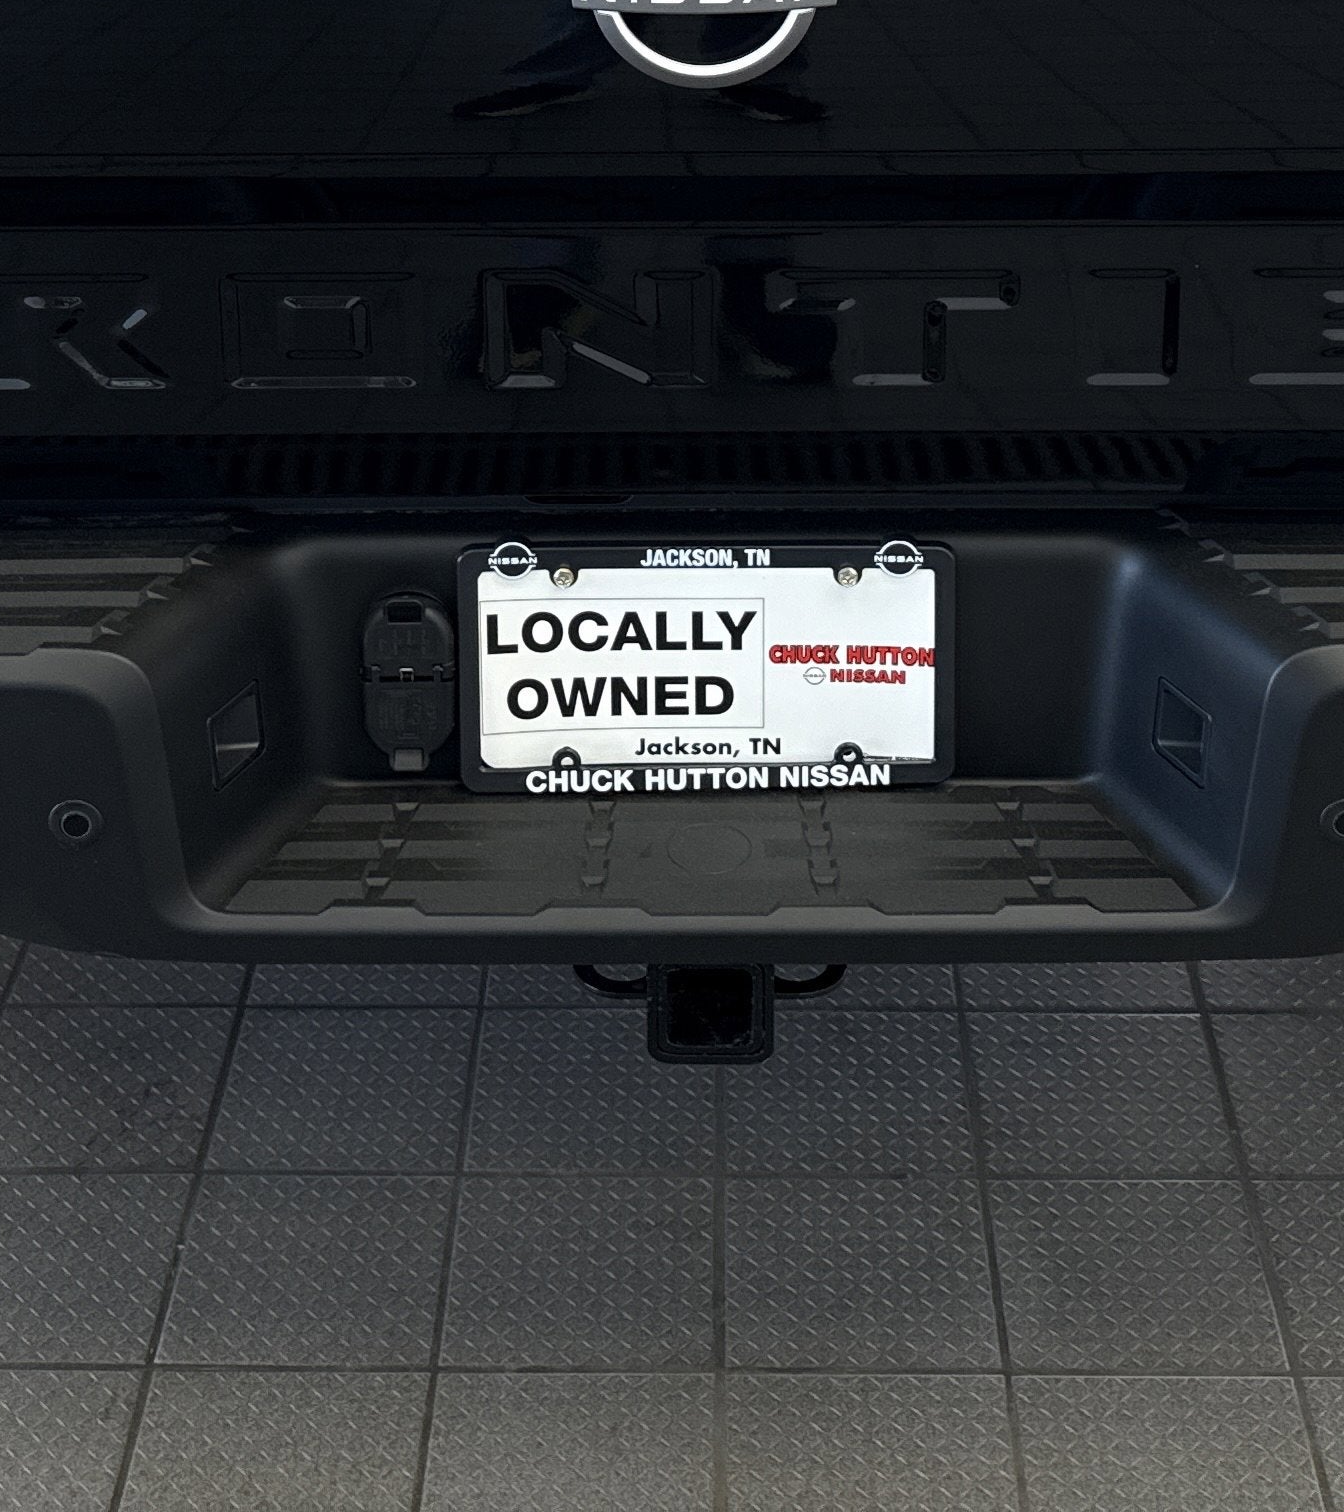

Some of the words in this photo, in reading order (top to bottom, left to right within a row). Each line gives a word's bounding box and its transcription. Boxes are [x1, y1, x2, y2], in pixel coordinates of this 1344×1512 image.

[487, 556, 538, 566] NISSAN
[640, 548, 739, 569] JACKSON,
[744, 548, 771, 567] TN
[873, 554, 924, 563] NISSAN
[485, 610, 757, 655] LOCALLY
[768, 644, 839, 665] CHUCK
[846, 644, 935, 667] HUTTON
[830, 668, 906, 684] NISSAN
[506, 676, 735, 720] OWNED
[635, 736, 741, 758] Jackson,
[749, 738, 782, 756] TN
[525, 769, 636, 793] CHUCK
[645, 766, 770, 792] HUTTON
[779, 763, 891, 788] NISSAN
